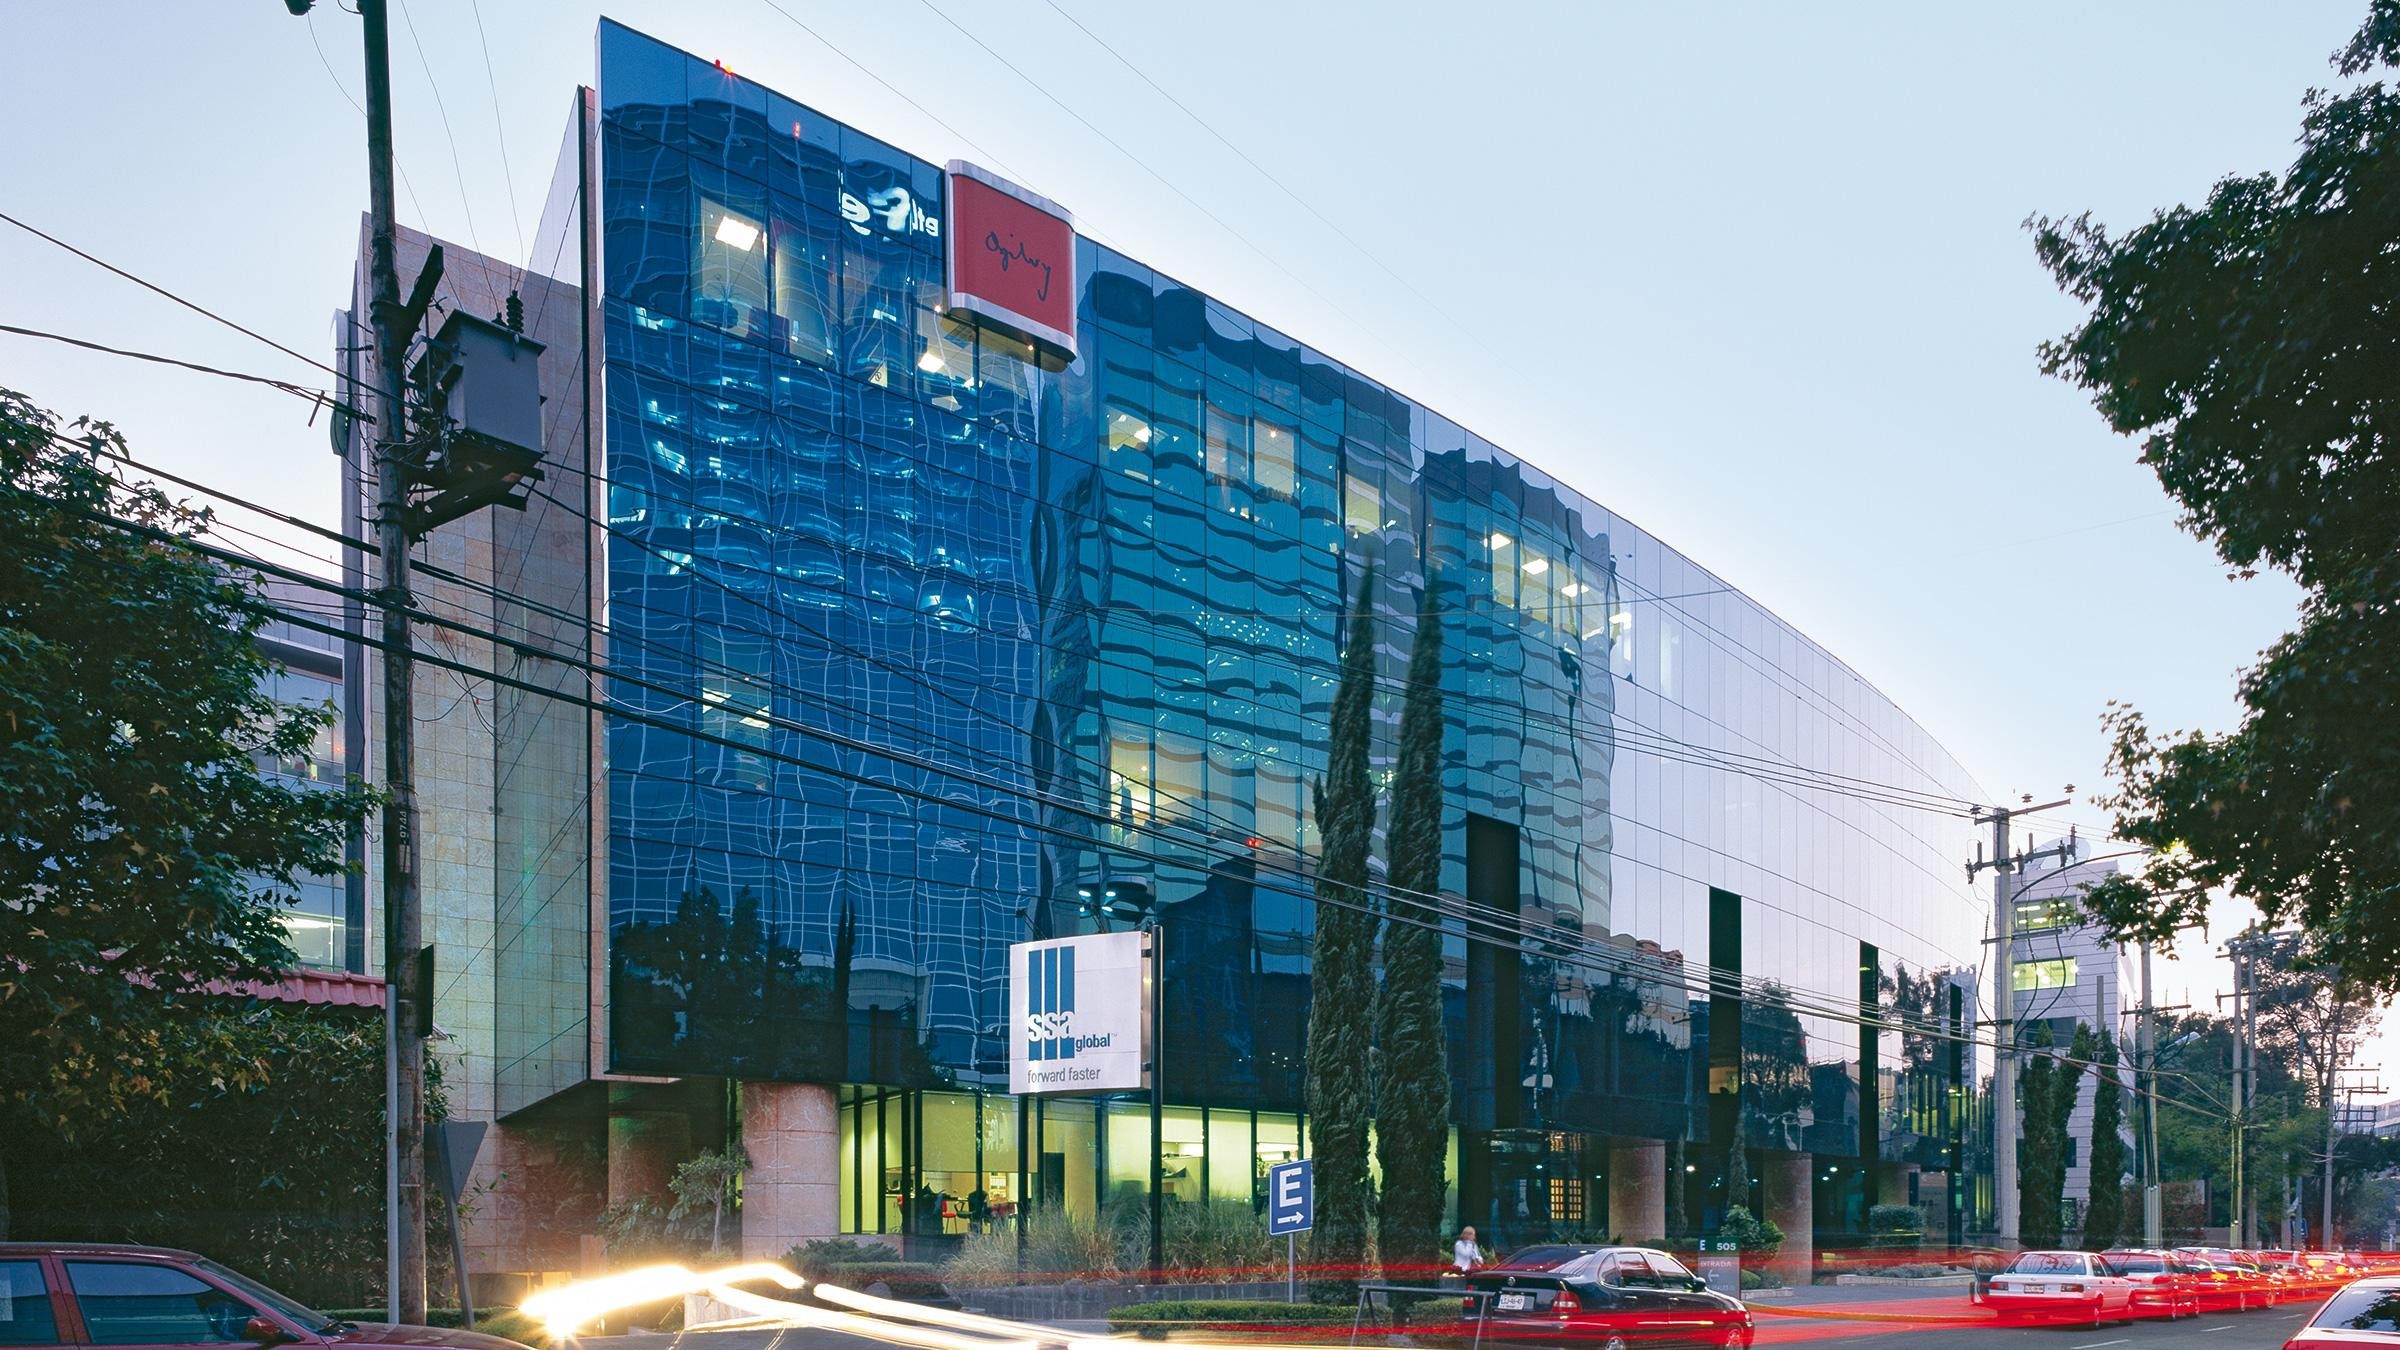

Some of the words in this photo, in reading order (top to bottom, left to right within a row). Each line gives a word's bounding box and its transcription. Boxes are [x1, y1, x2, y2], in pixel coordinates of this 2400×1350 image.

[985, 231, 1052, 302] Ogilvy
[1028, 1011, 1075, 1042] ssa
[1076, 1033, 1111, 1052] global
[1028, 1068, 1066, 1084] forward
[1068, 1067, 1101, 1081] faster
[1279, 1167, 1303, 1208] E
[1700, 1239, 1706, 1251] E
[1716, 1242, 1737, 1250] 505
